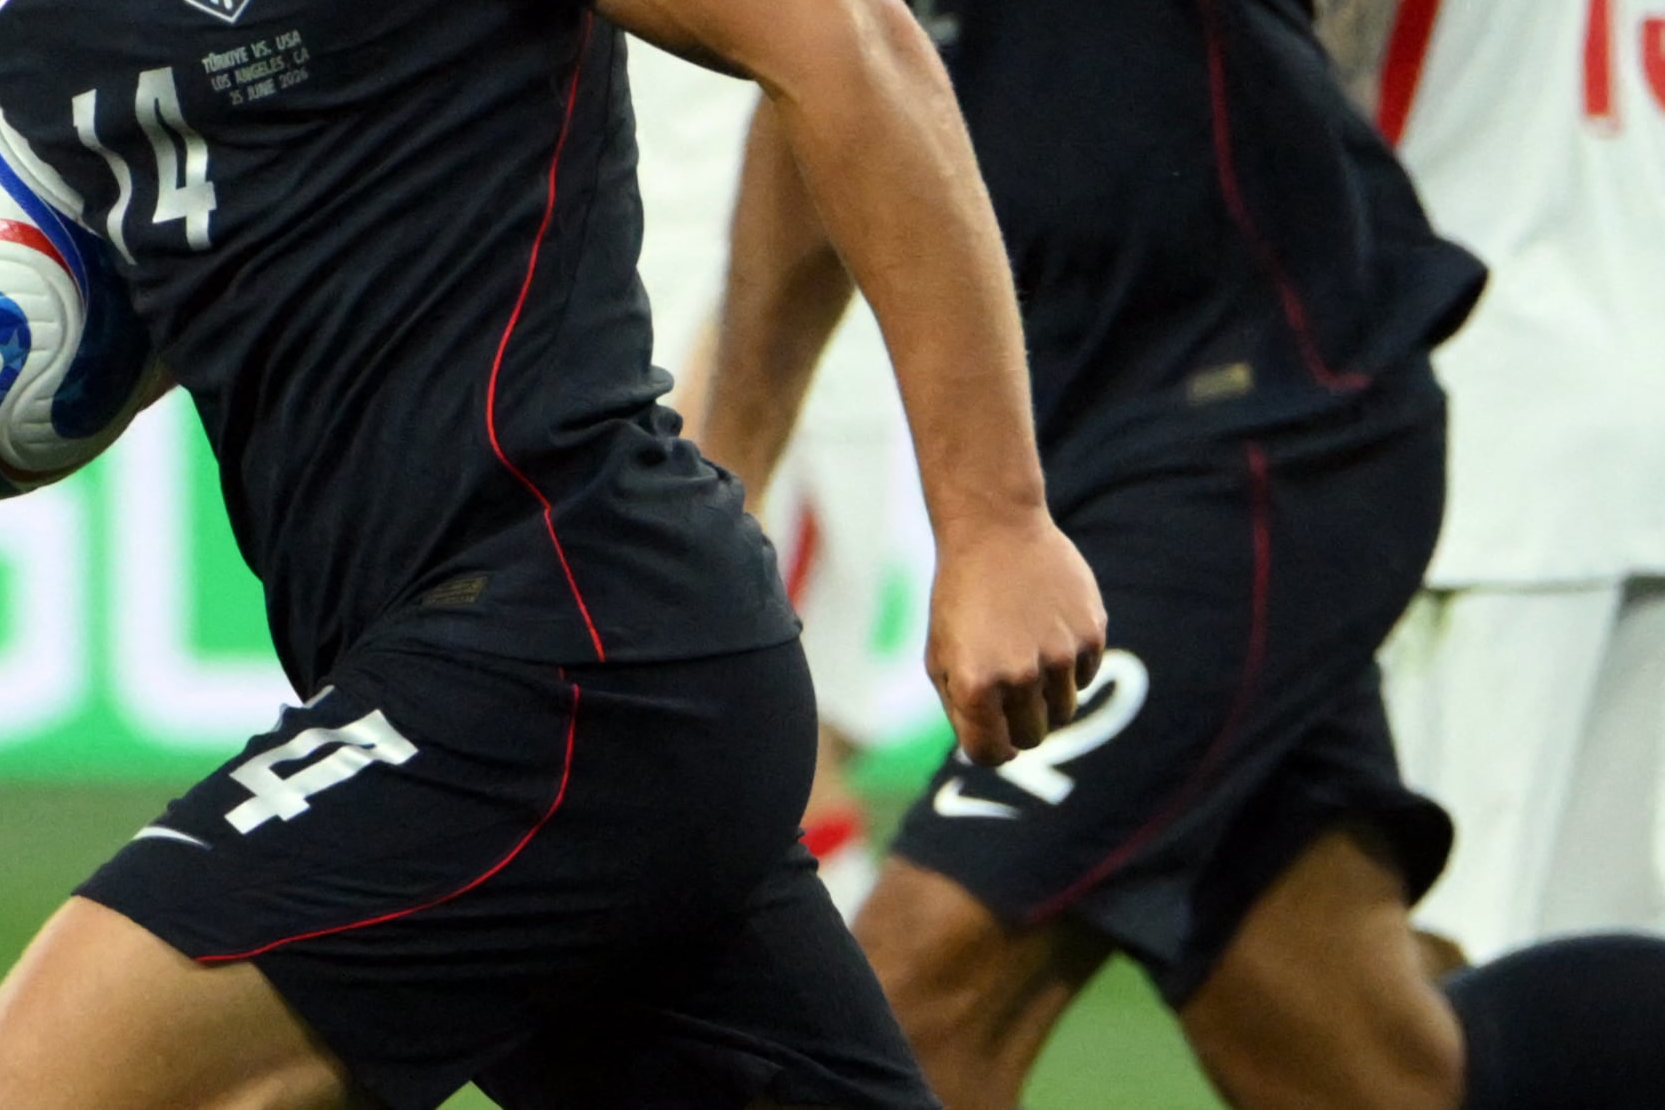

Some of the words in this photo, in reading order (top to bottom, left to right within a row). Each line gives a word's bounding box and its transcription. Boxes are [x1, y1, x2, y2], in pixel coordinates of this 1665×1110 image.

[211, 73, 232, 91] LOS
[293, 47, 310, 64] CA
[246, 78, 276, 101] JUNE
[278, 66, 309, 89] 2026
[275, 29, 302, 51] USA
[71, 66, 218, 266] 14
[223, 685, 420, 835] 4
[953, 648, 1150, 806] 2
